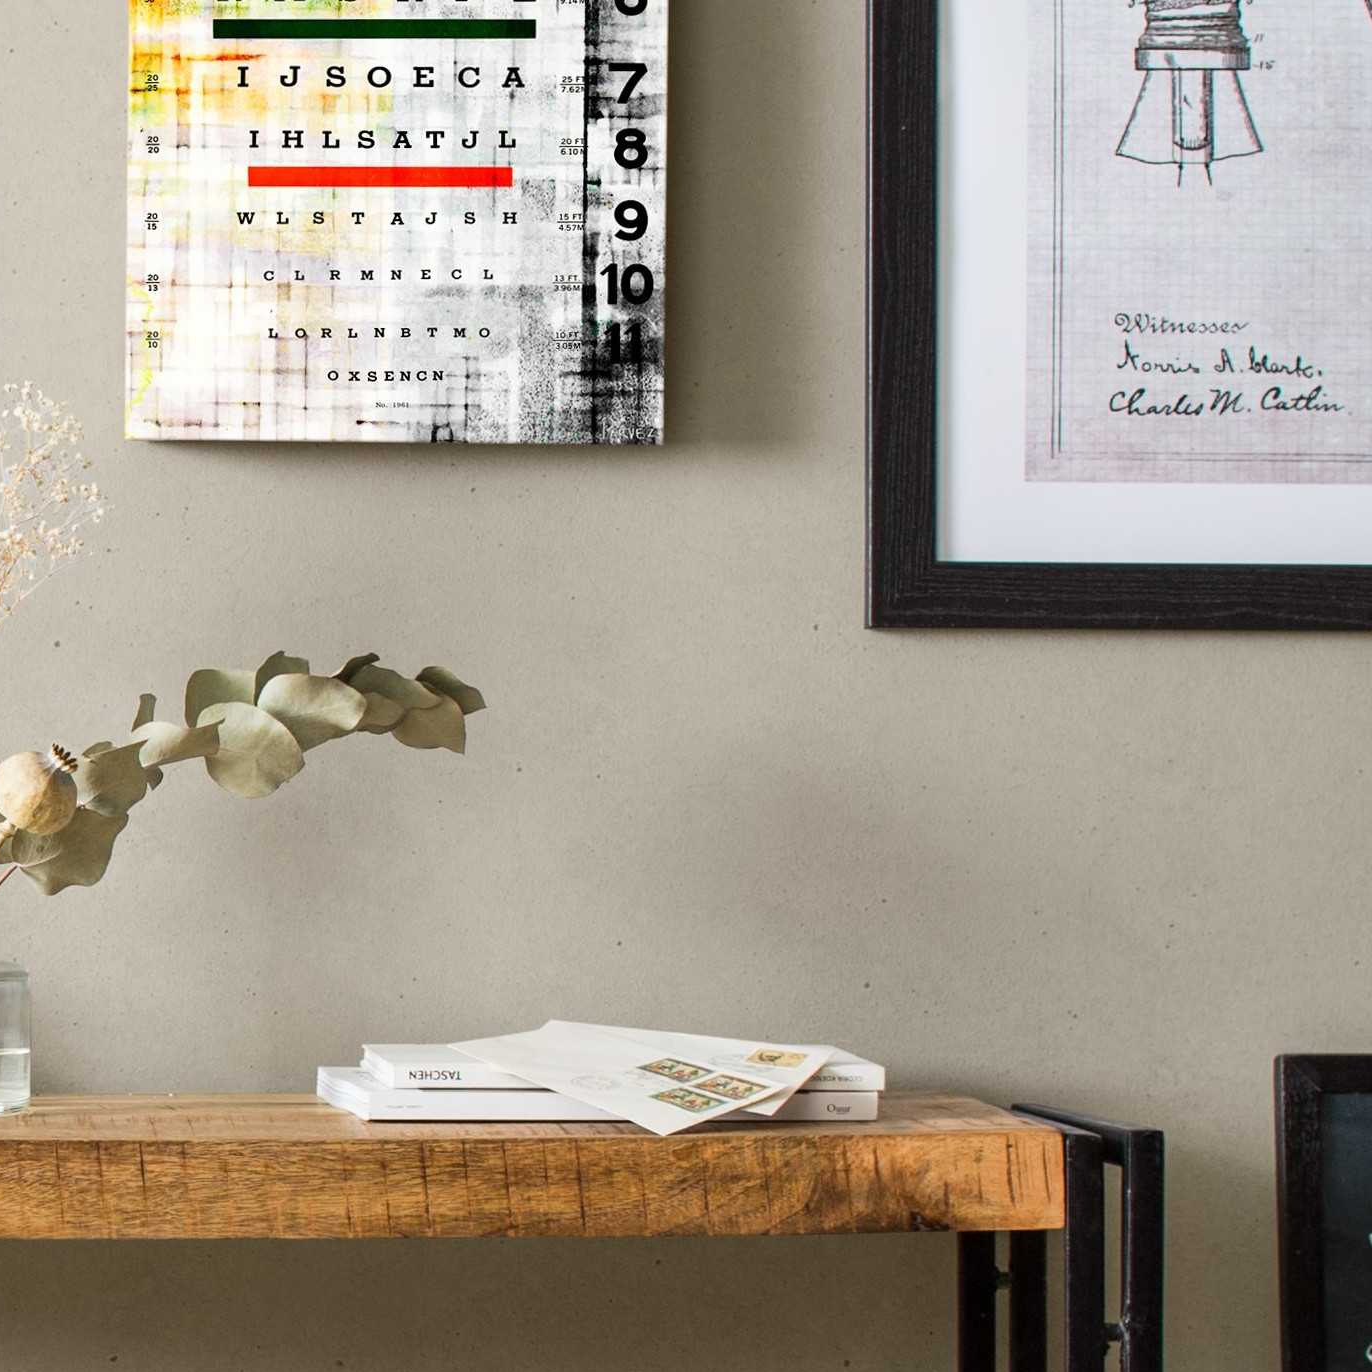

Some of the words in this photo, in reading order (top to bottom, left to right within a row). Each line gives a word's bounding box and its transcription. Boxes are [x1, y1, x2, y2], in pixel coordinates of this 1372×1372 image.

[147, 74, 159, 83] 20
[562, 75, 572, 83] 25
[607, 62, 649, 105] 7
[561, 137, 572, 145] 20
[147, 146, 159, 154] 20
[613, 127, 649, 170] 8
[558, 213, 569, 221] 15
[613, 199, 649, 242] 9
[146, 223, 158, 231] 15
[147, 274, 159, 282] 20
[554, 274, 565, 282] 13
[147, 284, 159, 292] 13
[599, 262, 655, 306] 10
[147, 331, 159, 339] 20
[555, 331, 566, 339] 10
[1108, 387, 1206, 417] Charles
[408, 1070, 462, 1081] TASCHEN
